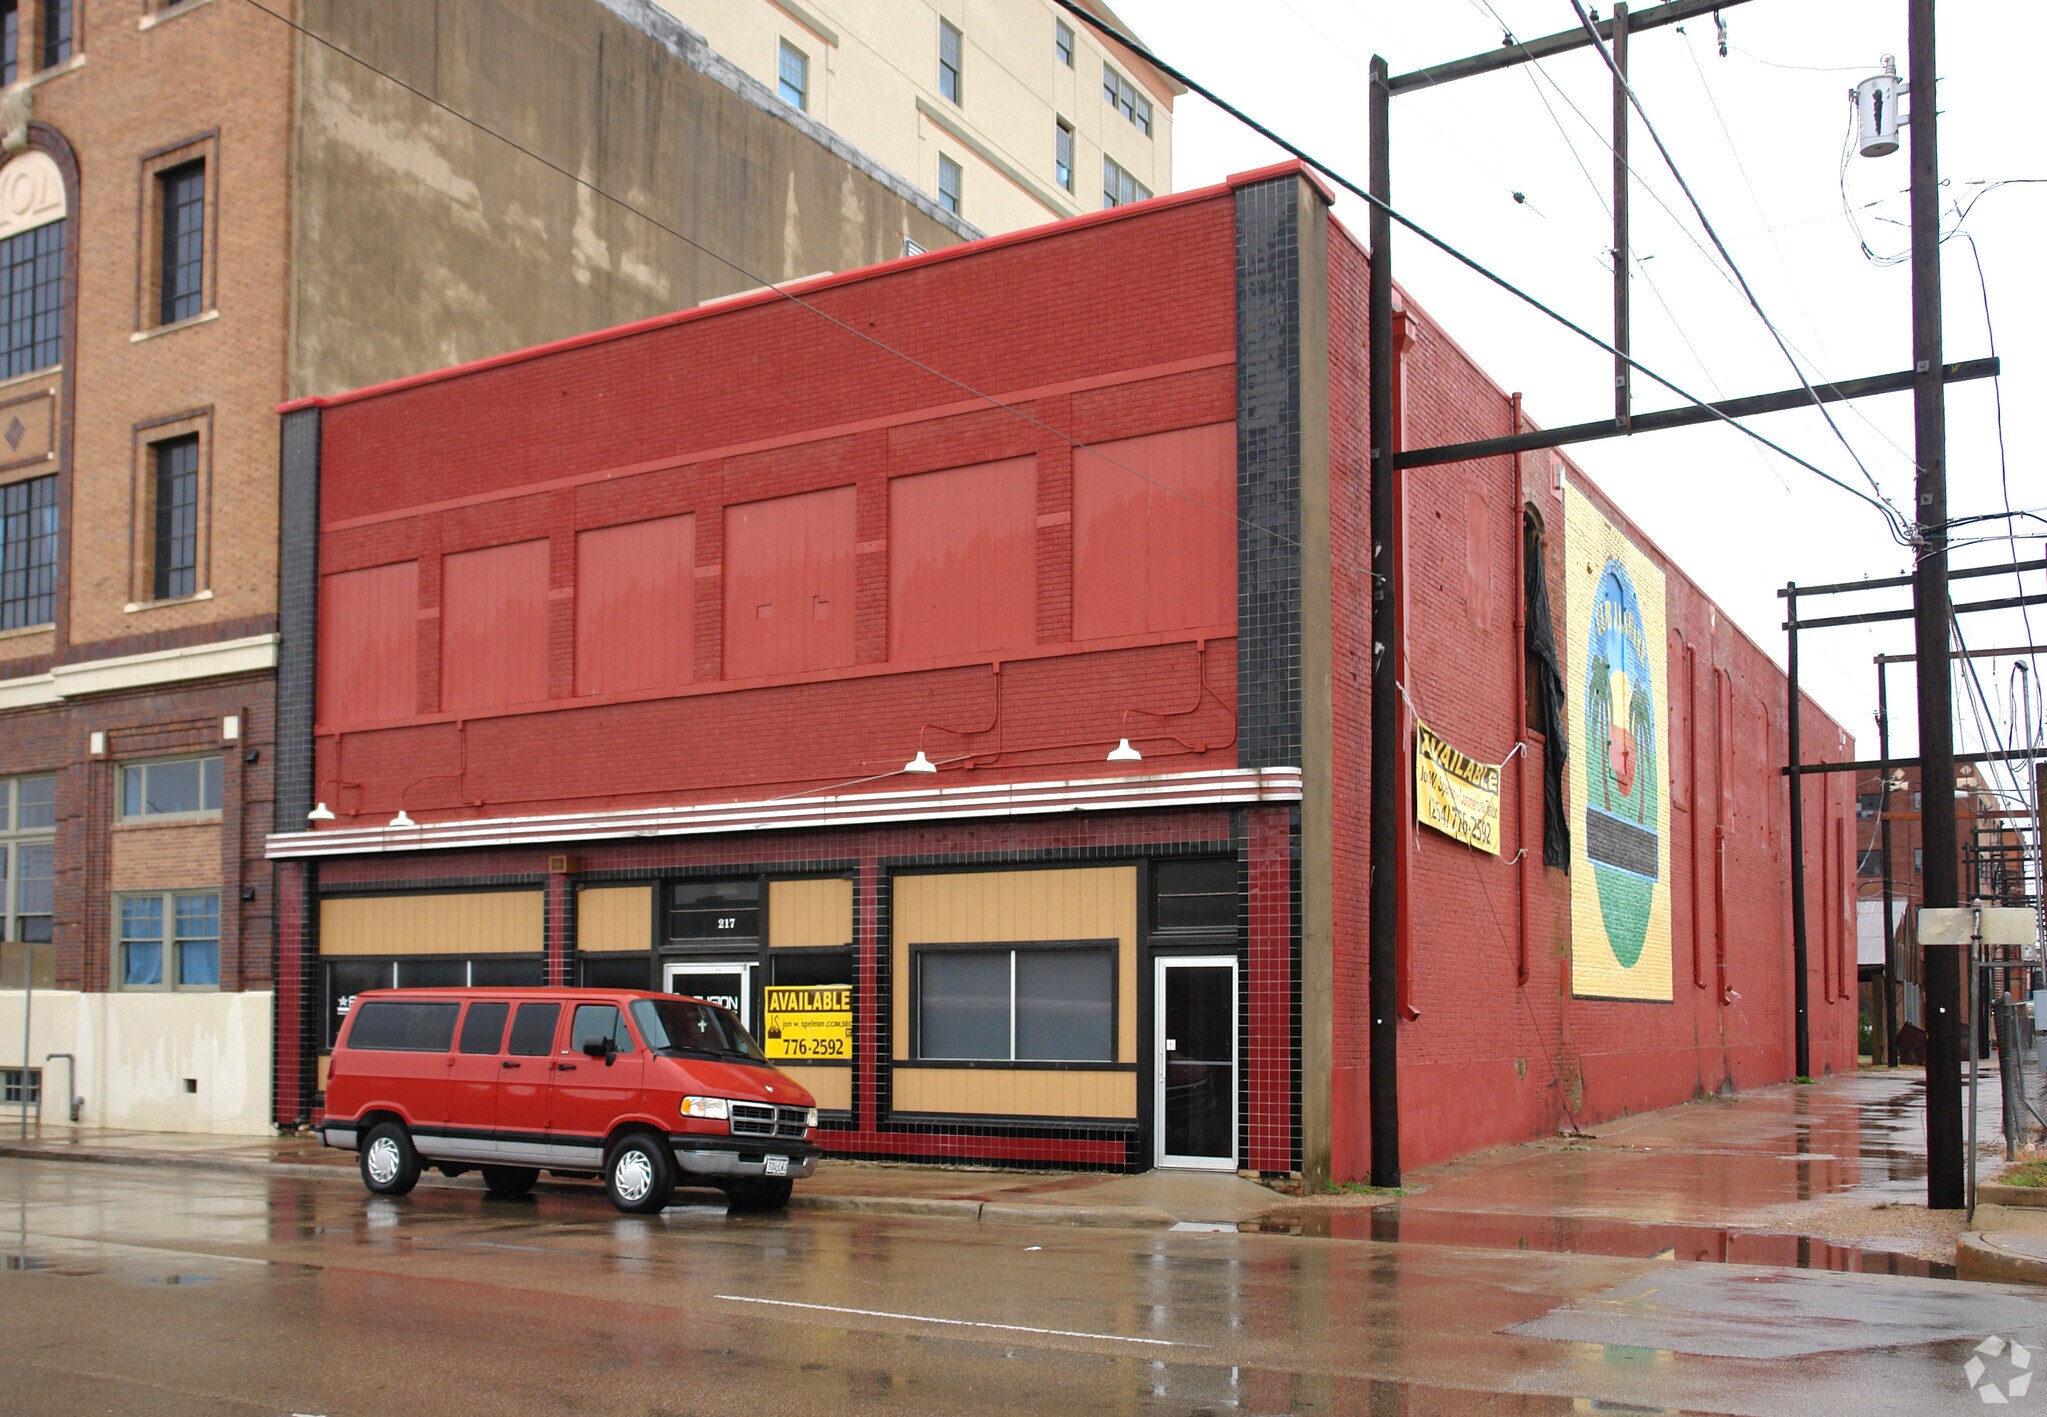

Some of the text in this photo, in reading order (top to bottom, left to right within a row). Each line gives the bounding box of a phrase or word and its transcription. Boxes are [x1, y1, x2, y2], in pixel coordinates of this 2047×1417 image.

[1420, 732, 1498, 793] AVAILABLE
[717, 918, 736, 929] 217
[769, 991, 851, 1011] AVAILABLE
[782, 1019, 793, 1031] jon
